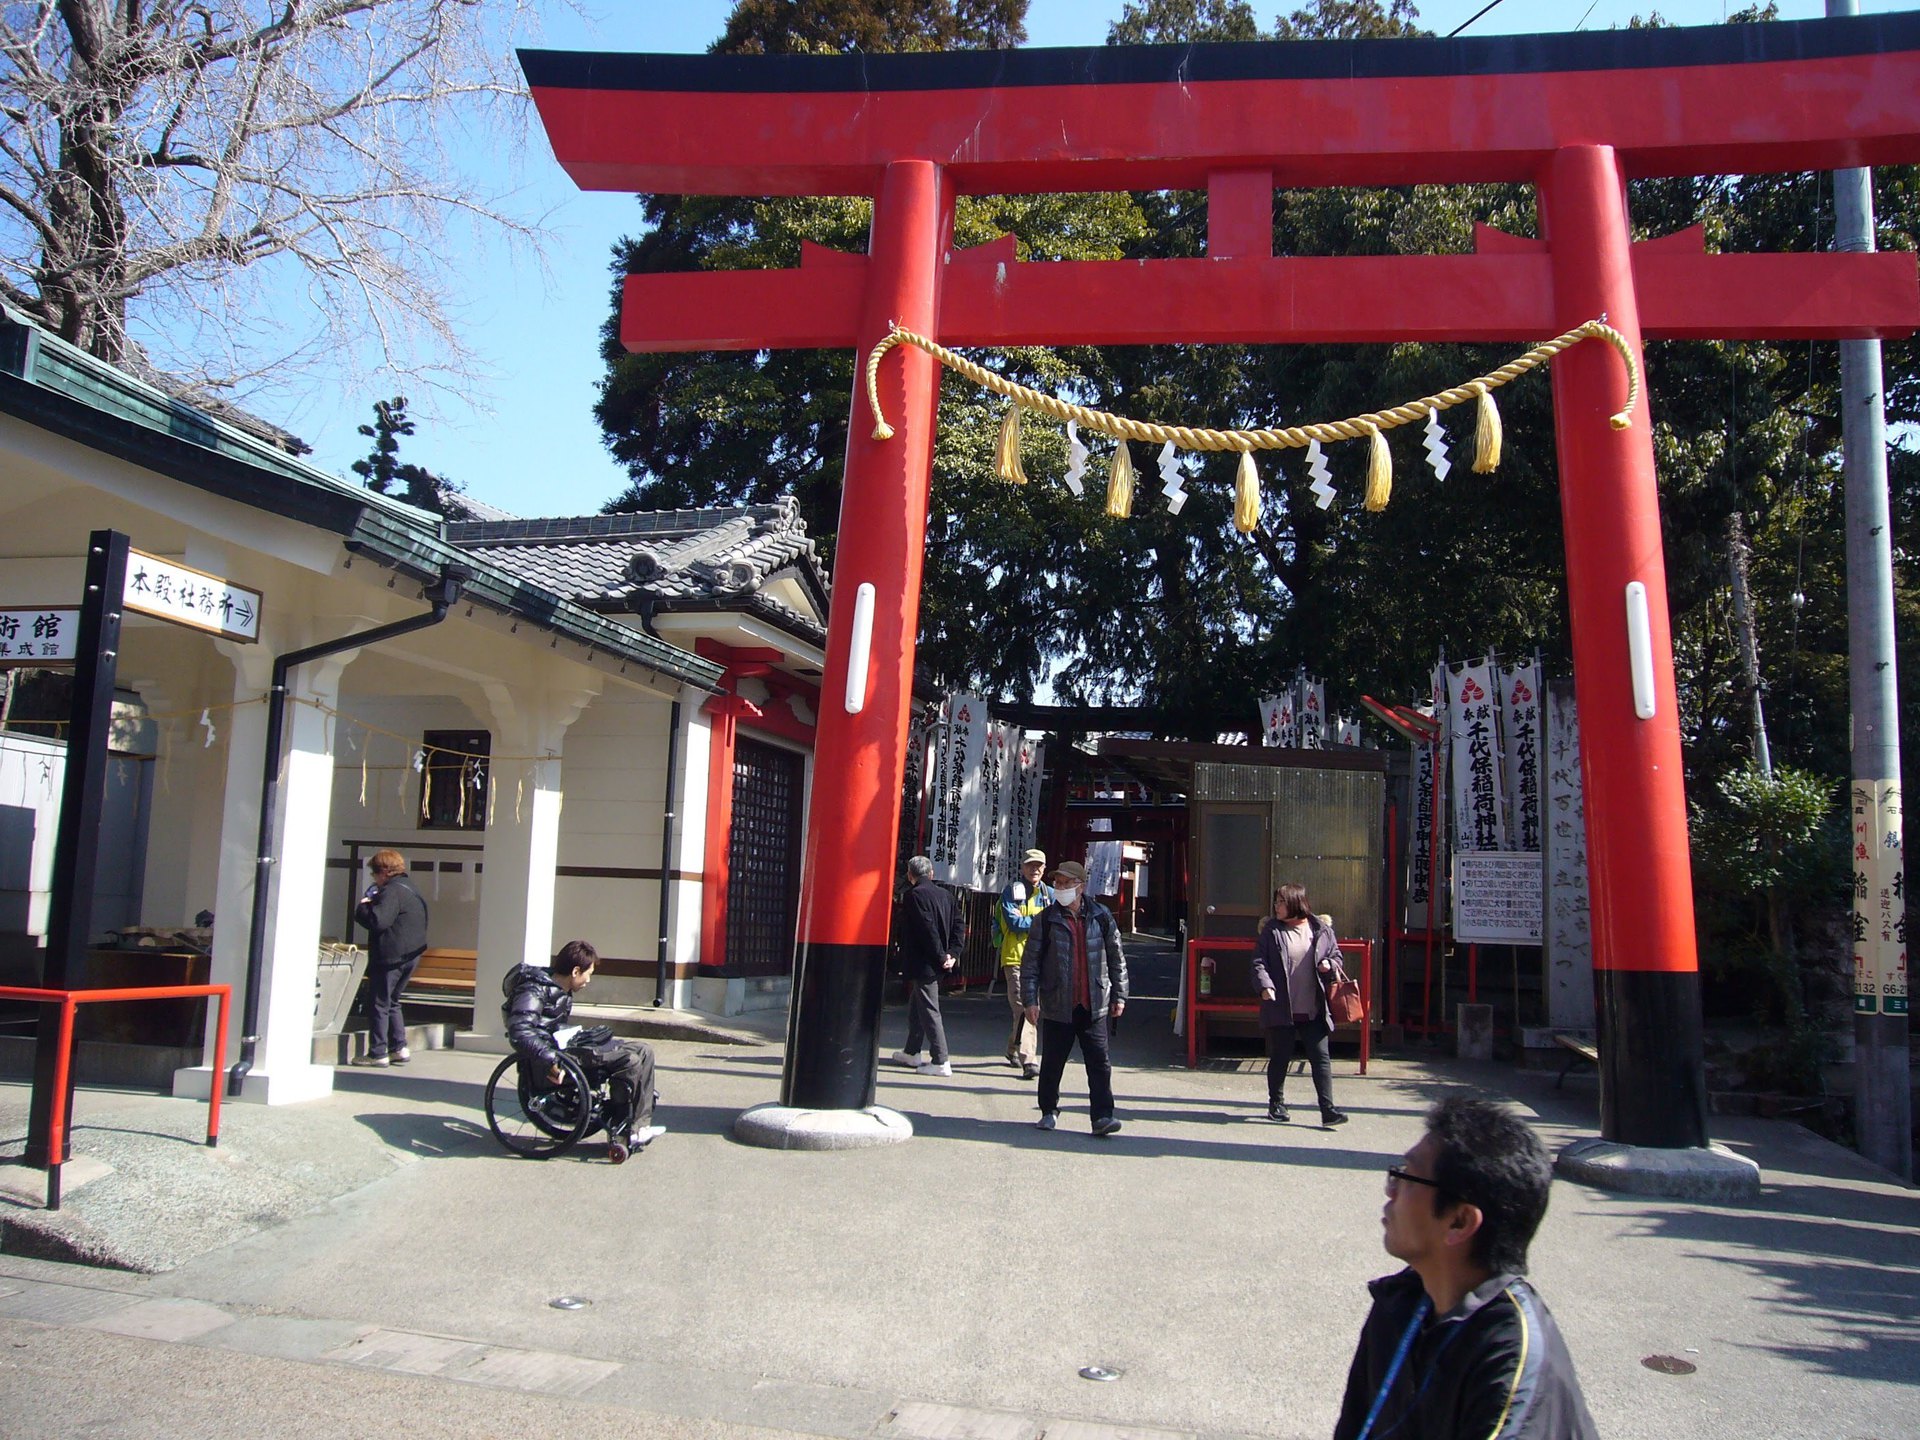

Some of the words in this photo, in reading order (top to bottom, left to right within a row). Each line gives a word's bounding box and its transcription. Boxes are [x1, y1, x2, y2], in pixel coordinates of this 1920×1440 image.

[130, 565, 235, 625] 本殿・社務所
[0, 613, 62, 640] 術館
[1463, 703, 1491, 723] 奉献
[1466, 722, 1498, 851] 千代保稲荷神社
[1515, 723, 1541, 851] 千代保稲荷神社
[1856, 822, 1870, 861] 川魚
[1880, 888, 1892, 943] 送迎バス有
